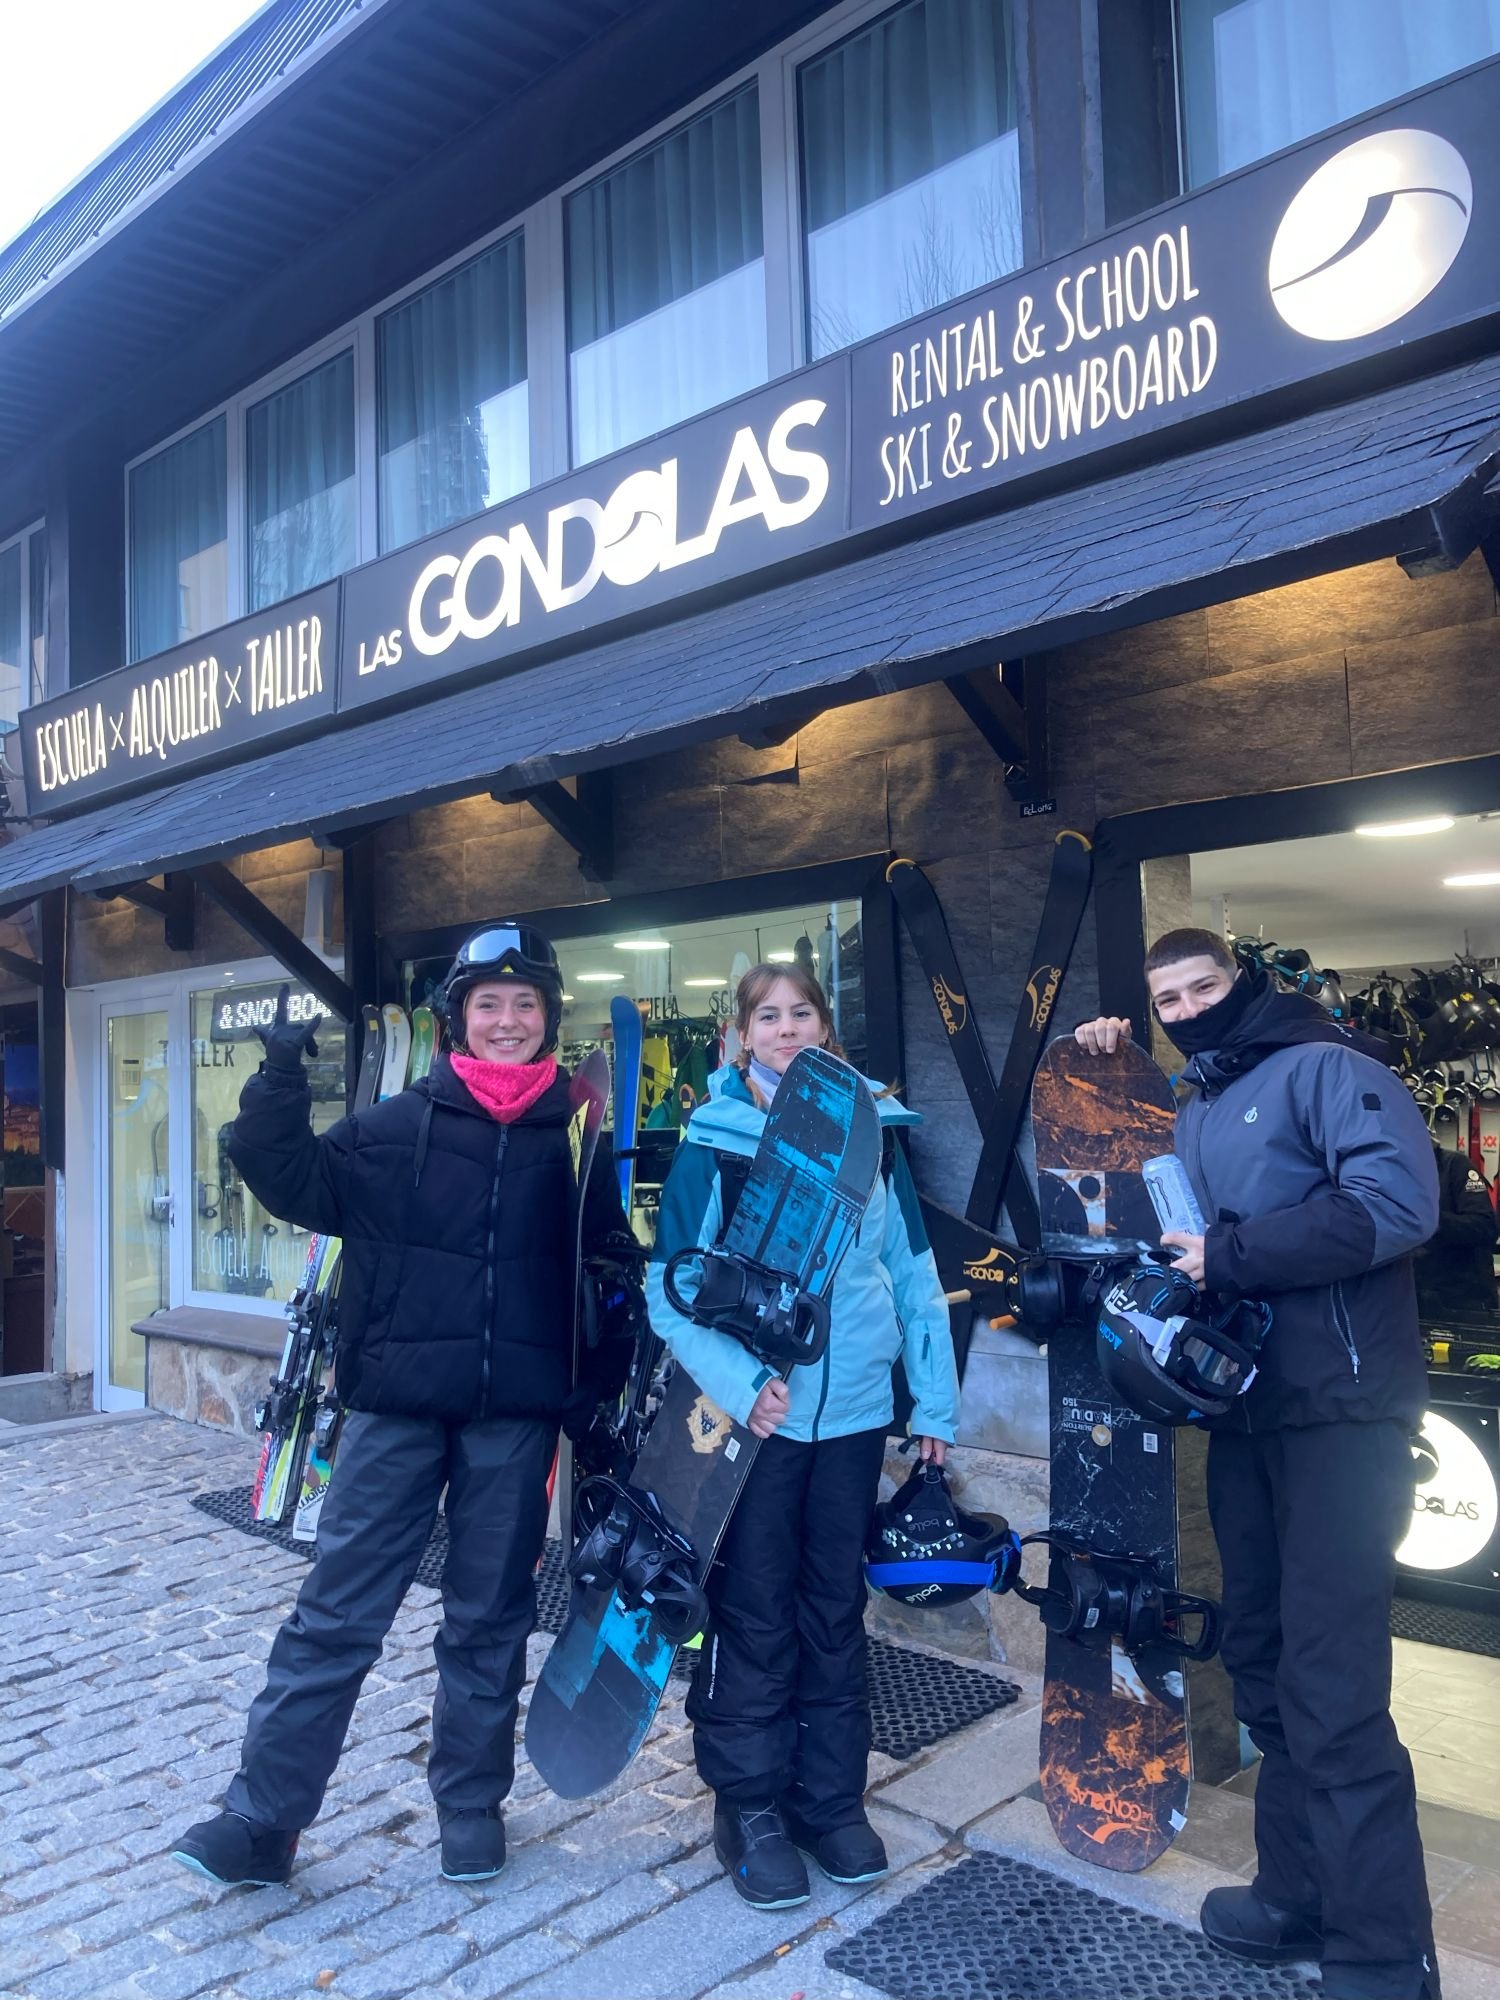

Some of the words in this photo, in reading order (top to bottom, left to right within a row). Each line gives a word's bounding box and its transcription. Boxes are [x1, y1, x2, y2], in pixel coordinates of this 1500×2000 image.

[890, 308, 1004, 417] RENTAL
[1013, 295, 1047, 365] &
[1054, 225, 1200, 354] SCHOOL
[879, 422, 933, 507] SKI
[941, 411, 973, 480] &
[981, 315, 1219, 470] SNOWBOARD
[358, 628, 403, 676] LAS
[407, 399, 830, 657] GONDOLAS
[35, 702, 107, 792] ESCUELA
[128, 655, 222, 761] ALQUILER
[245, 615, 324, 715] TALLER
[219, 1004, 233, 1030] &
[934, 983, 958, 1035] GONDOLAS
[1036, 967, 1062, 1024] GONDOLAS
[200, 1230, 249, 1279] ESCUELA
[1062, 1407, 1112, 1426] RADIUS
[1412, 1494, 1479, 1521] DOLAS
[1070, 1787, 1142, 1822] GONDOLAS
